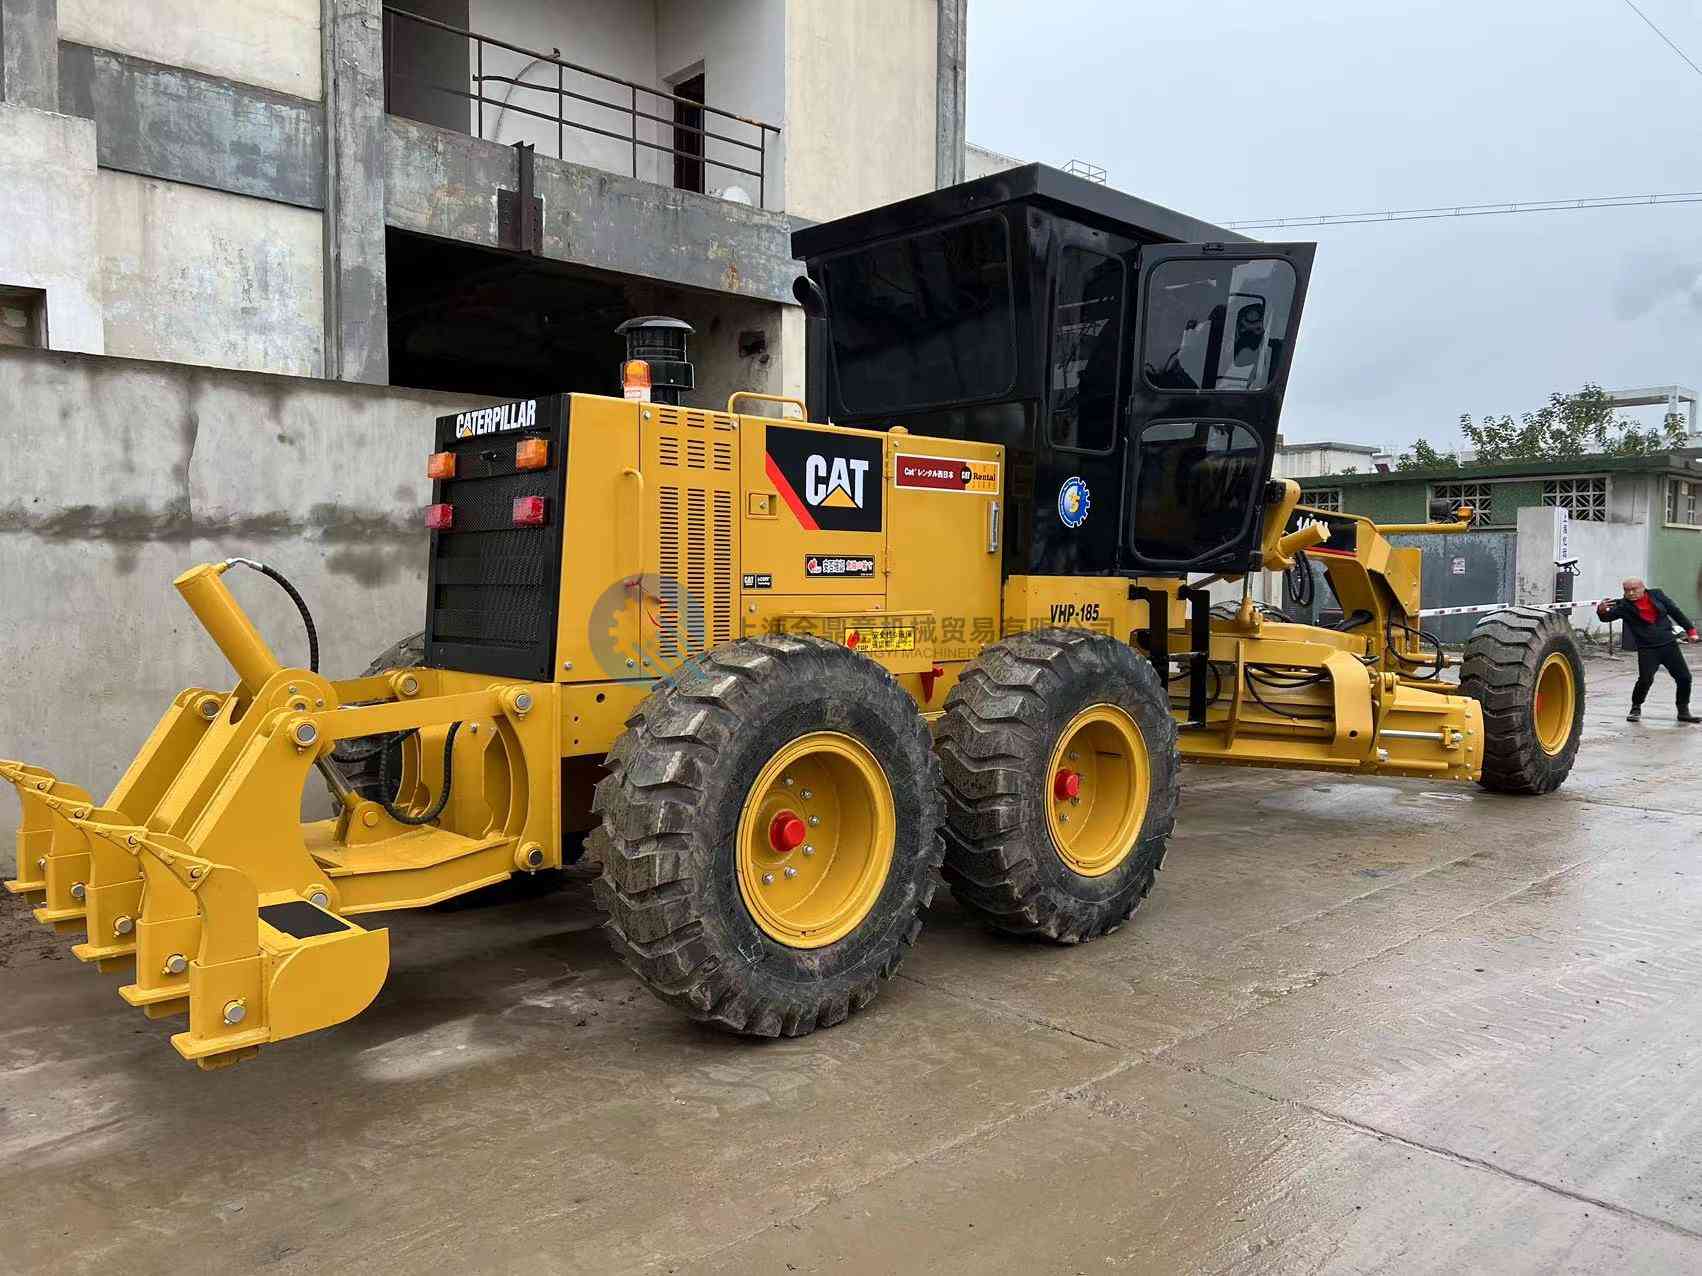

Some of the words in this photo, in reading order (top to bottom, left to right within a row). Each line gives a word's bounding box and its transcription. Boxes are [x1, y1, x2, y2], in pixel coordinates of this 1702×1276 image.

[456, 400, 536, 438] CATERPILLAR
[805, 454, 869, 509] CAT
[973, 473, 996, 481] Rental
[1050, 603, 1100, 623] VHP-185
